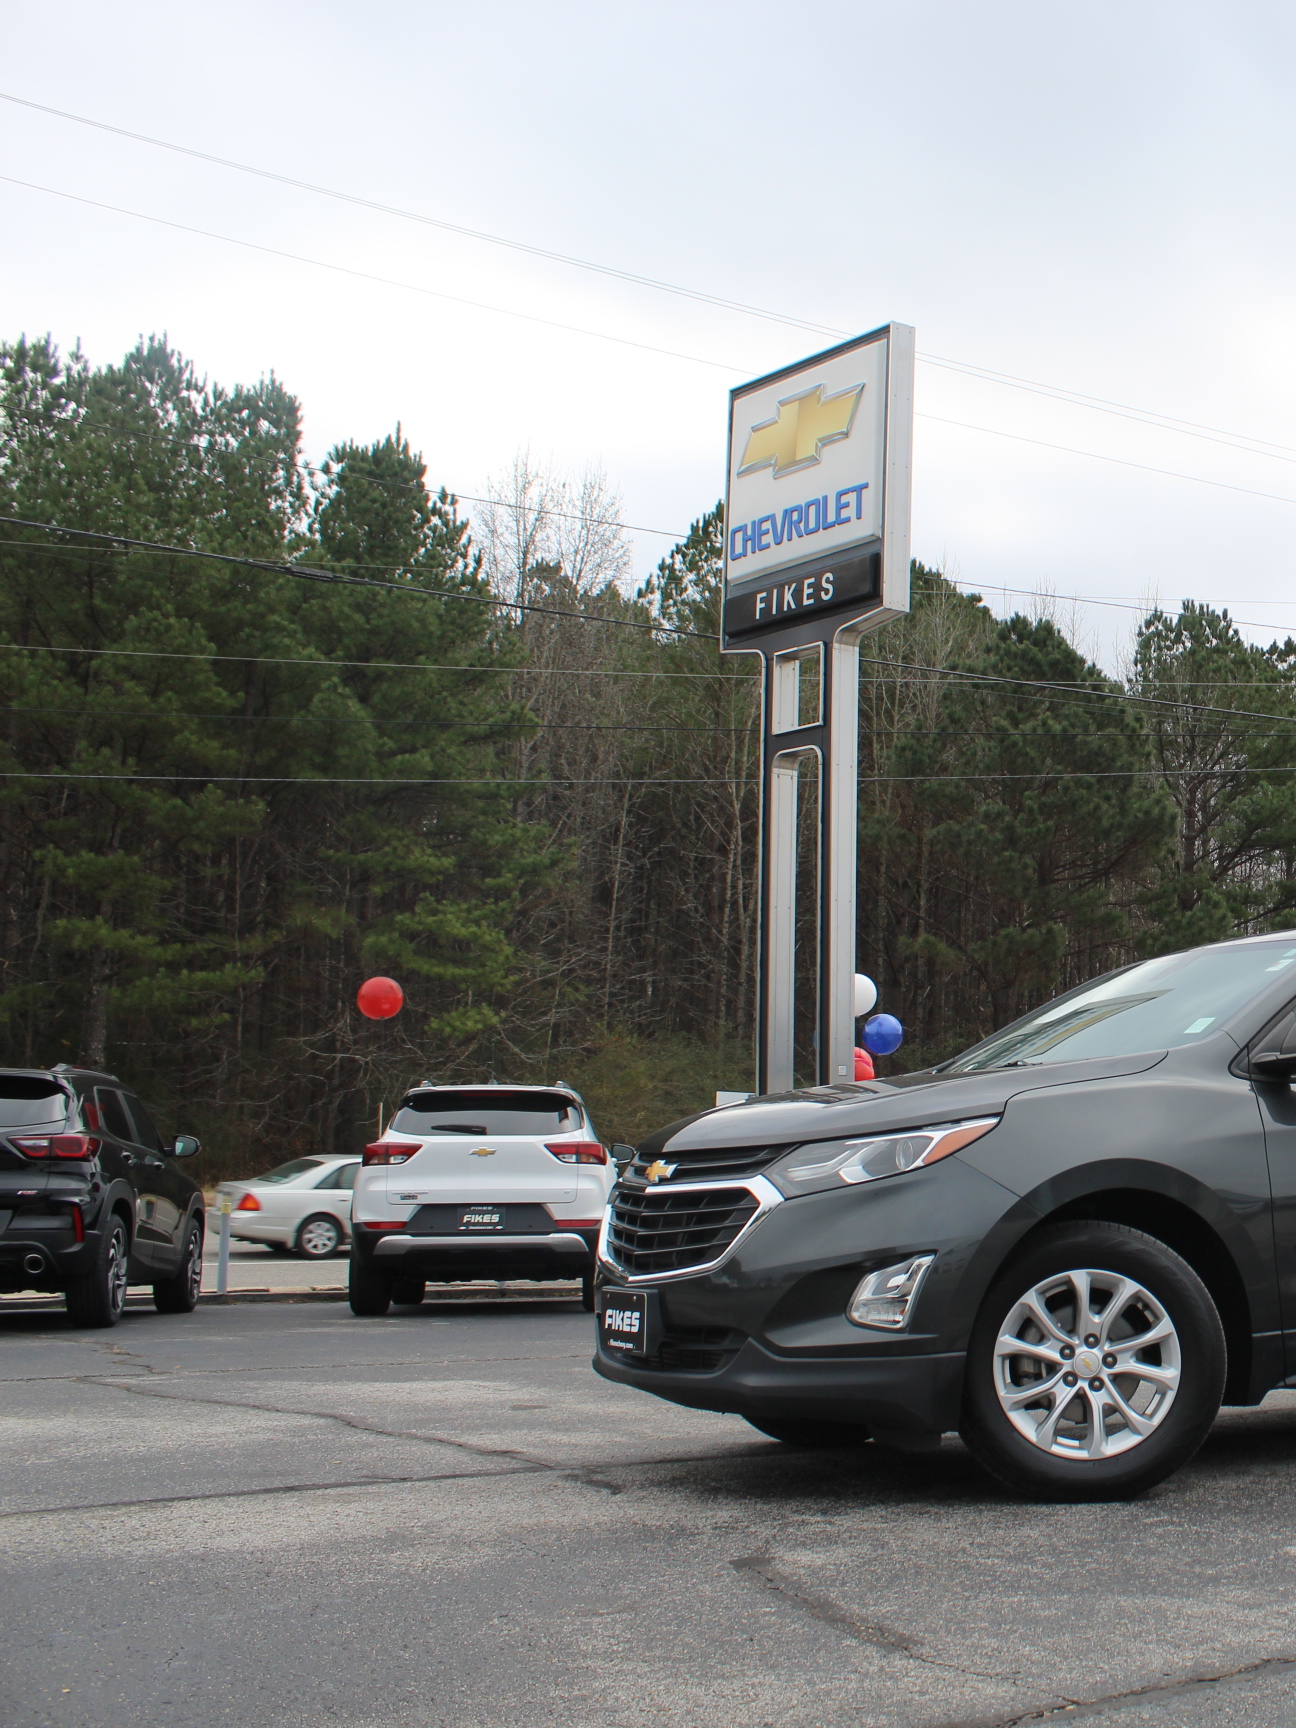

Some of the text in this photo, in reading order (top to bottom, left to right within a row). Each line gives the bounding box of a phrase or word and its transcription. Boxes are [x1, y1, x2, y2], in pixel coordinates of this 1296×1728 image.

[729, 481, 869, 561] CHEVROLET
[755, 572, 835, 620] FIKES
[462, 1214, 500, 1223] FIKES
[604, 1308, 641, 1333] FIKES
